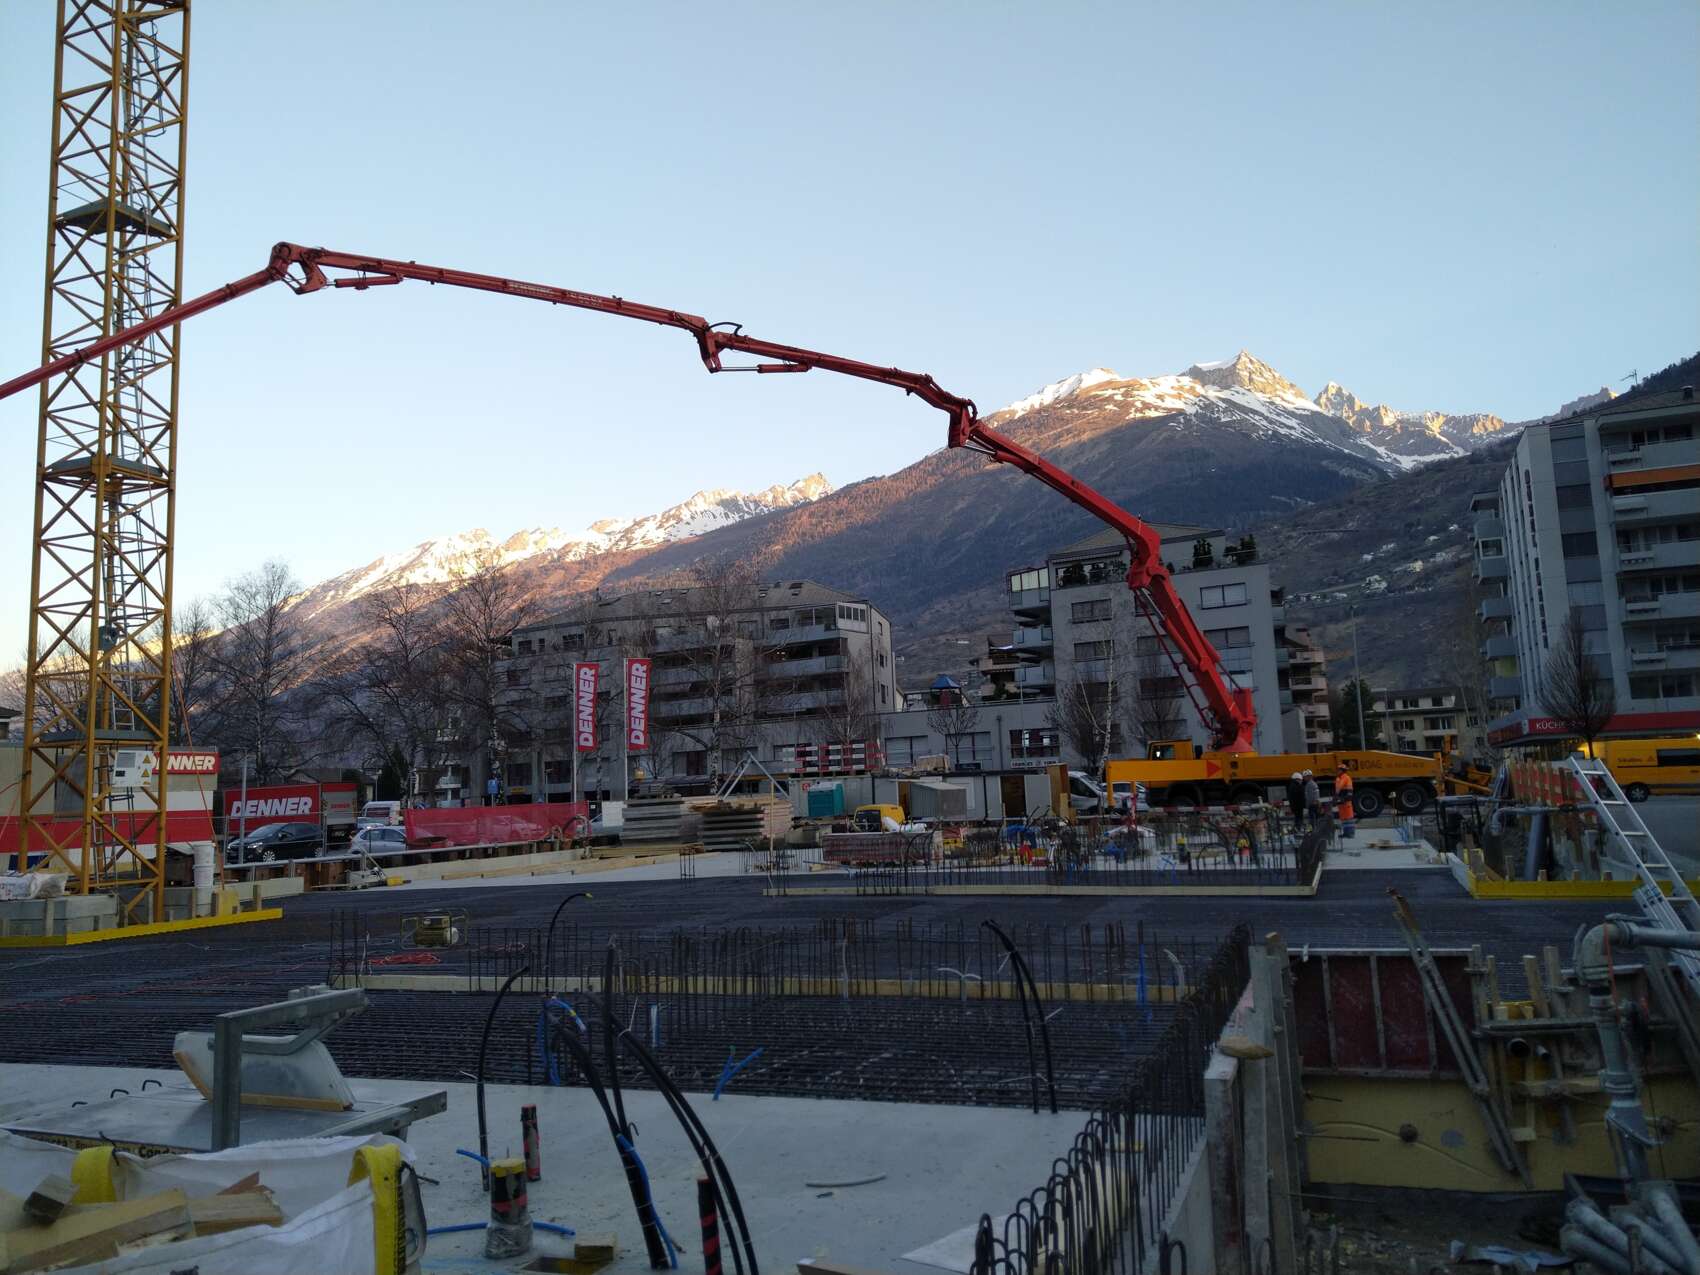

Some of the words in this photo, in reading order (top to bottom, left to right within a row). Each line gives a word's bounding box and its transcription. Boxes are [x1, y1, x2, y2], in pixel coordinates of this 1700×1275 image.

[578, 667, 596, 746] DENNER
[630, 663, 648, 745] DENNER
[230, 796, 313, 818] DENNER
